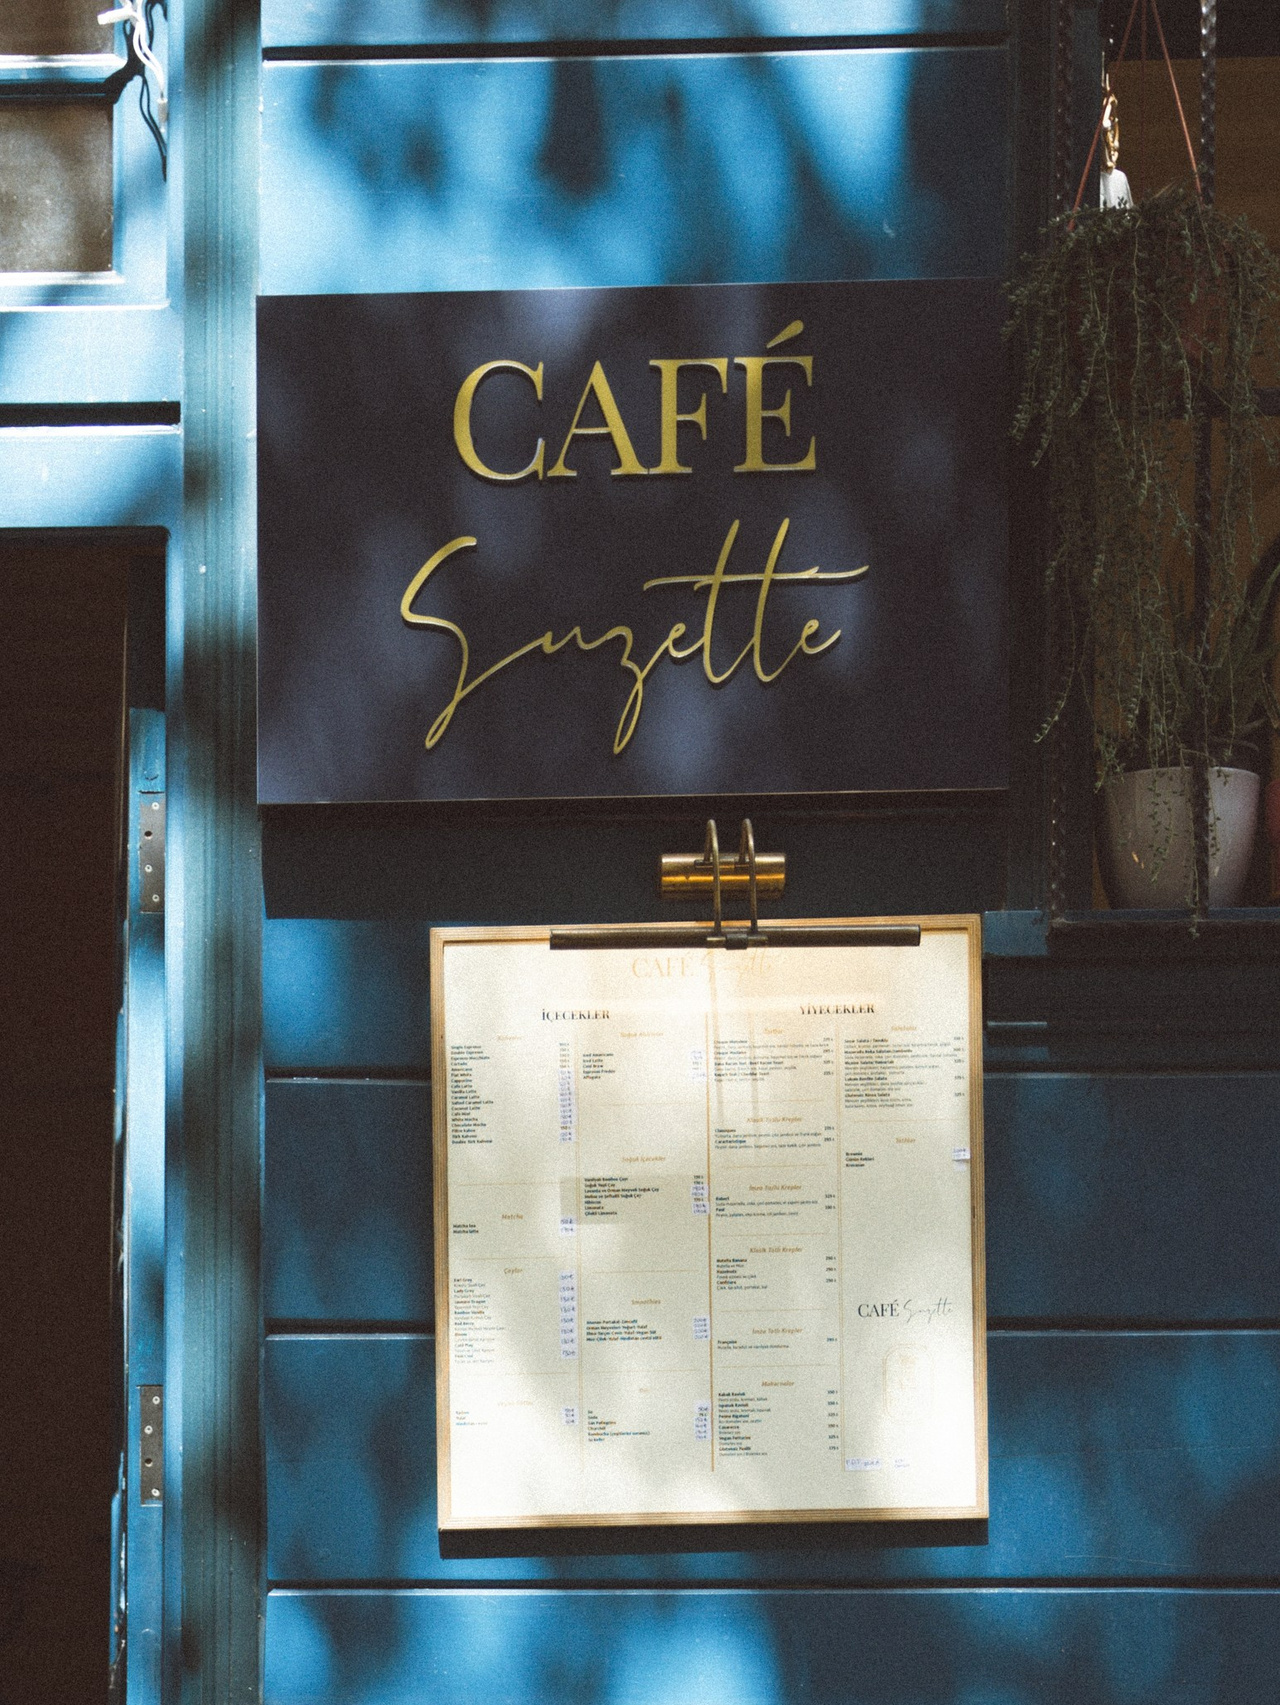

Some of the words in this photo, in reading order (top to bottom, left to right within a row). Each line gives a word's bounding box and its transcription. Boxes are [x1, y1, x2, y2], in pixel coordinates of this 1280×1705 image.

[453, 319, 817, 481] CAFÉ
[400, 518, 870, 754] Suzette
[542, 1008, 610, 1022] İÇECEKLER
[799, 1003, 875, 1015] YİYECEKLER
[858, 1299, 899, 1318] CAFÉ
